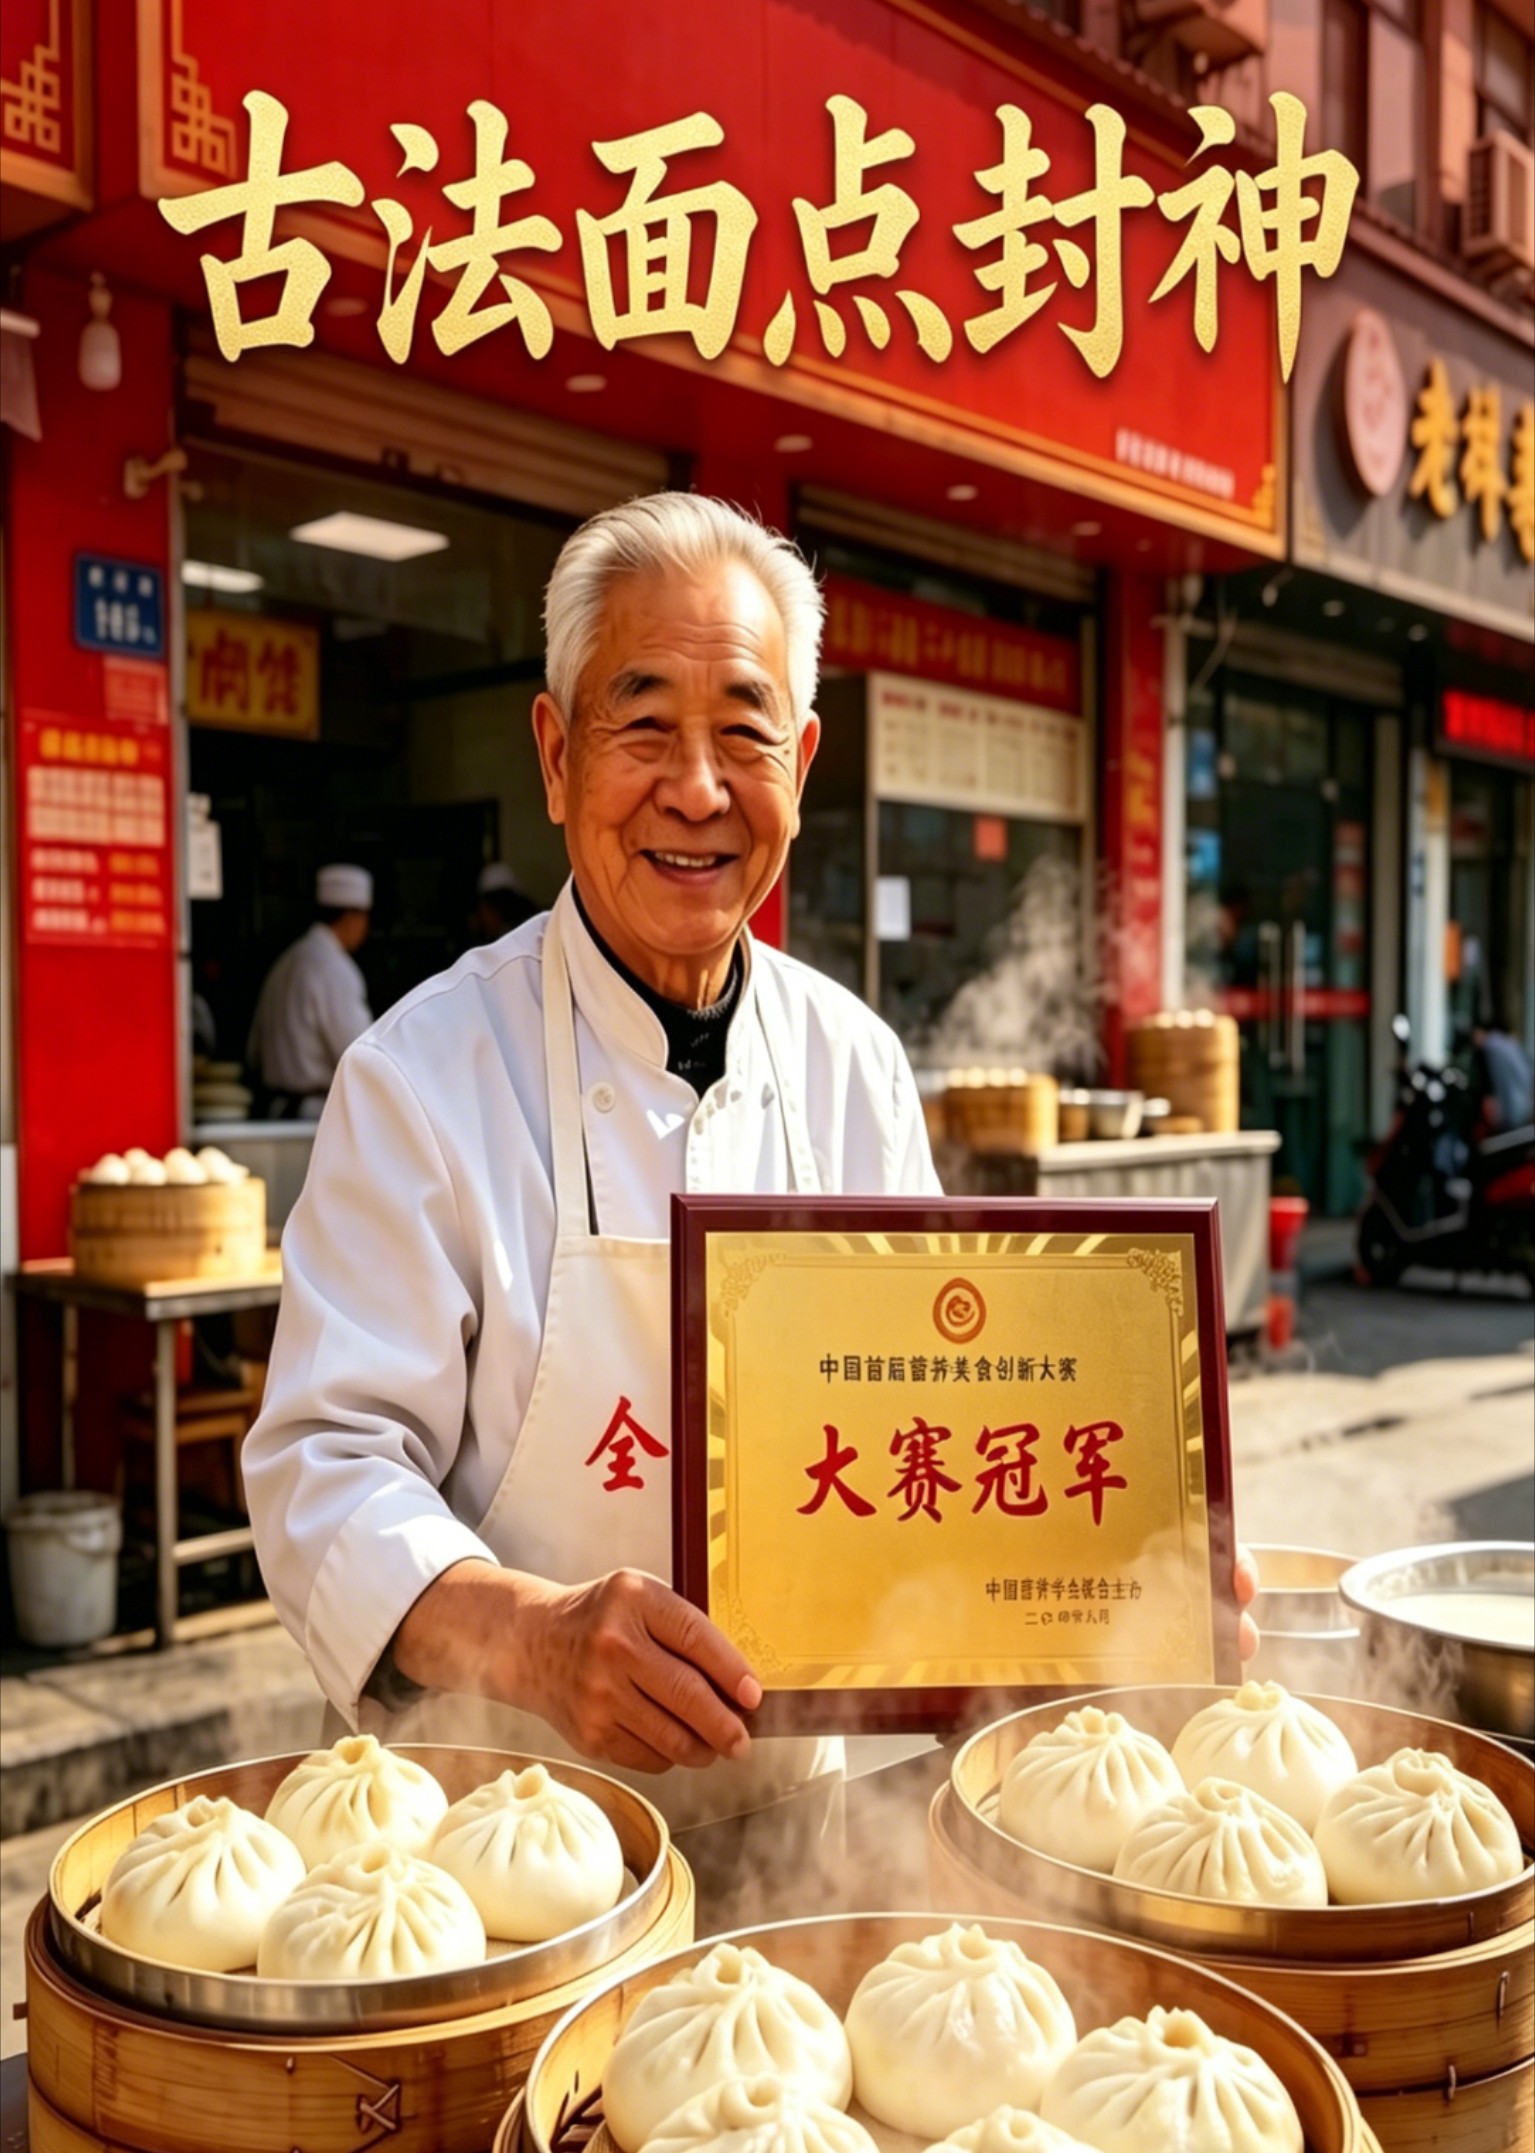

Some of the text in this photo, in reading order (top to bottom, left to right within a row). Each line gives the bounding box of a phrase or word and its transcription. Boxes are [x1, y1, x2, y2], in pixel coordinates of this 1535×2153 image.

[585, 1396, 669, 1492] 全
[796, 1416, 1129, 1526] 大赛冠军
